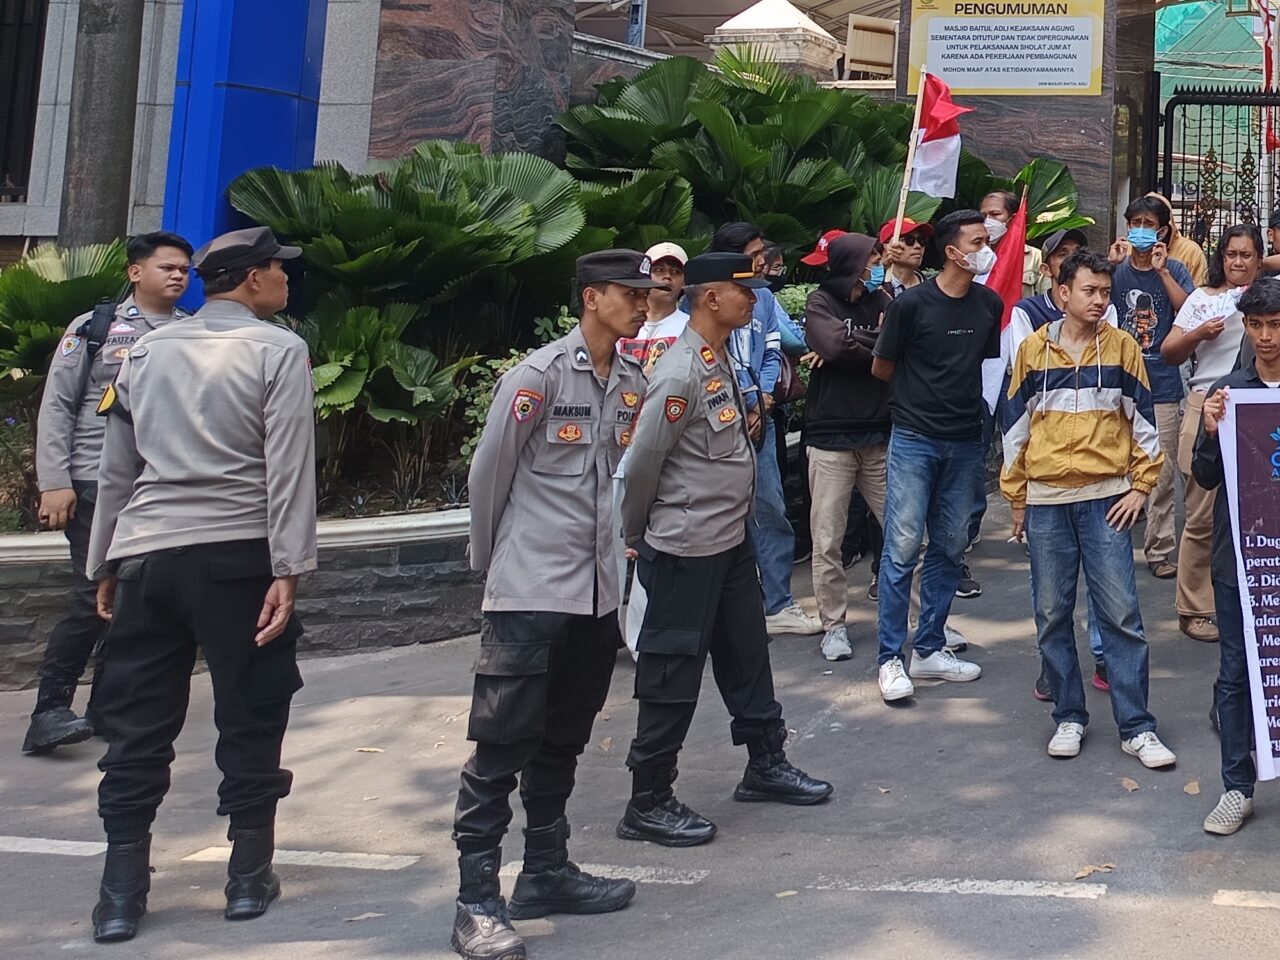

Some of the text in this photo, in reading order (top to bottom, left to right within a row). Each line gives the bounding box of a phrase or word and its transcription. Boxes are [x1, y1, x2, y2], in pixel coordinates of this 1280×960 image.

[954, 3, 1068, 15] PENGUMUMAN
[706, 391, 730, 410] IWAN
[553, 405, 591, 418] MAKSUM
